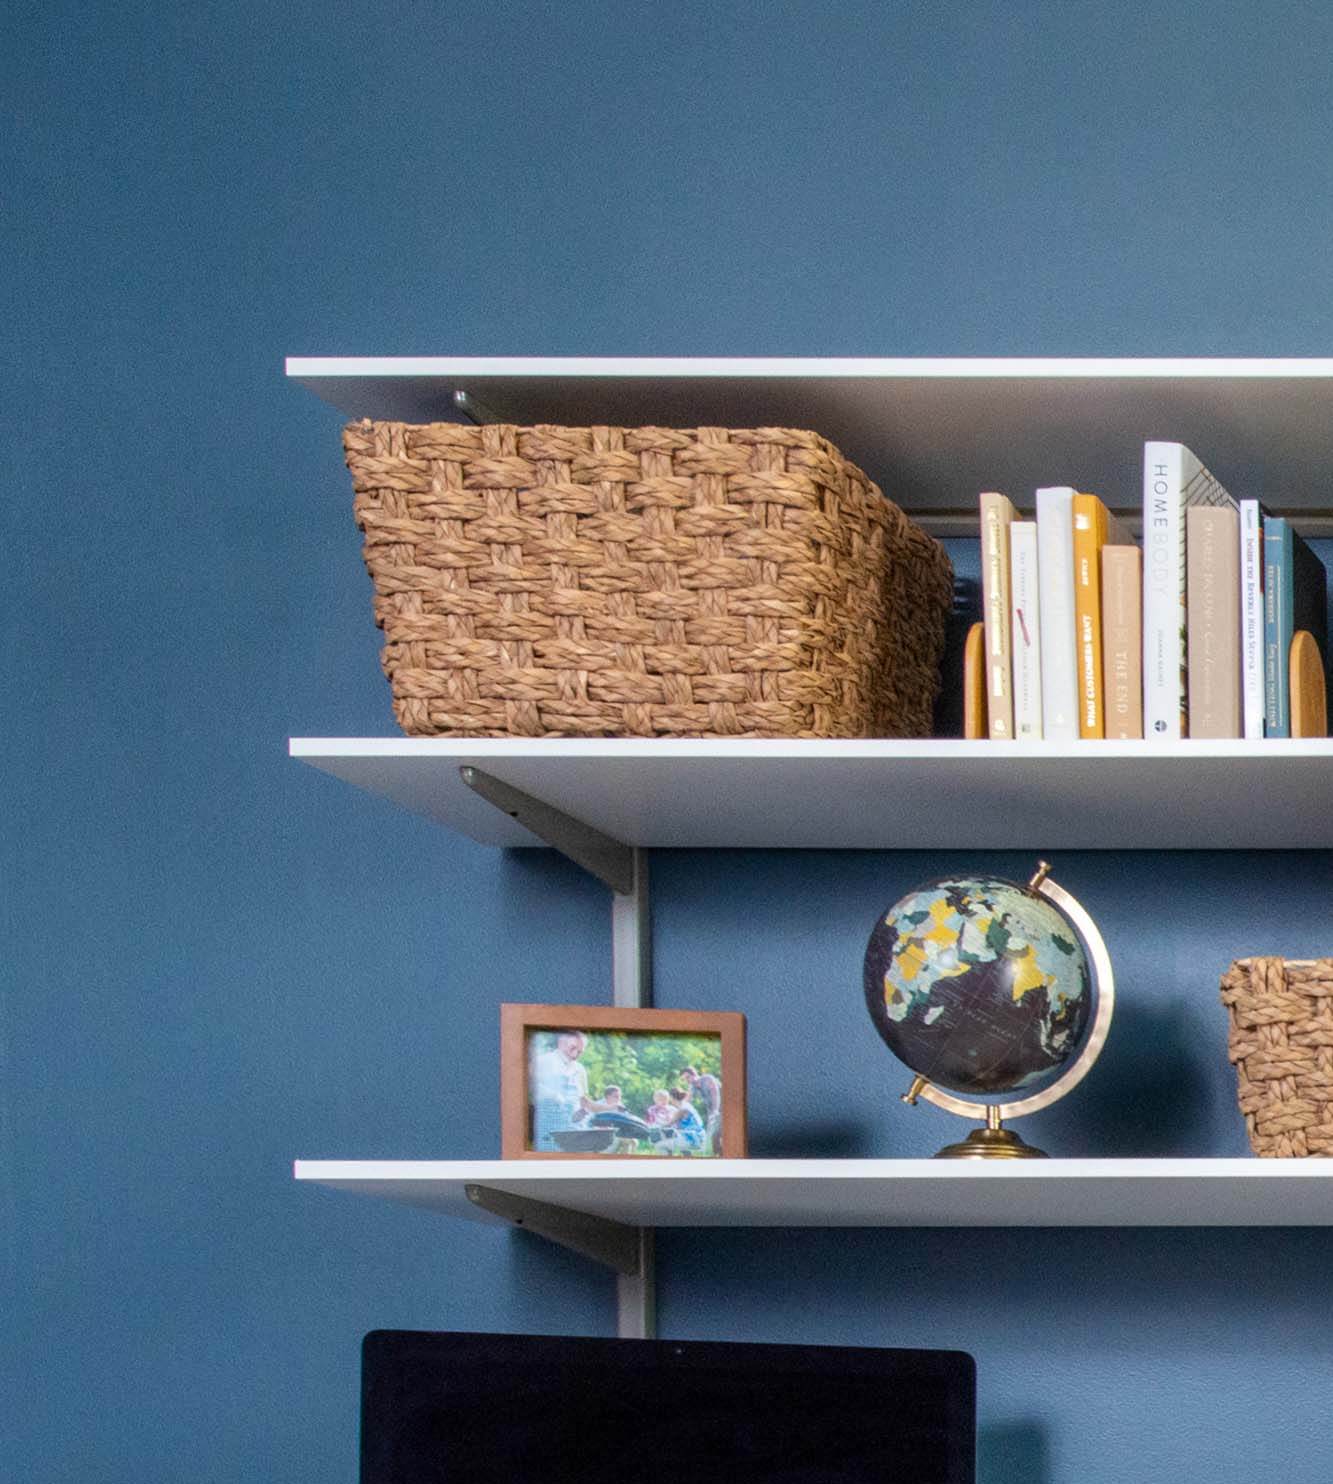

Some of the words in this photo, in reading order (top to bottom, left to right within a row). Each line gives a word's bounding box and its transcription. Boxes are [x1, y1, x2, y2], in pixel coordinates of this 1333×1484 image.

[1084, 643, 1096, 699] CUSTOMERS
[1115, 650, 1128, 681] THE
[1115, 685, 1128, 713] END
[1085, 700, 1097, 728] WHAT
